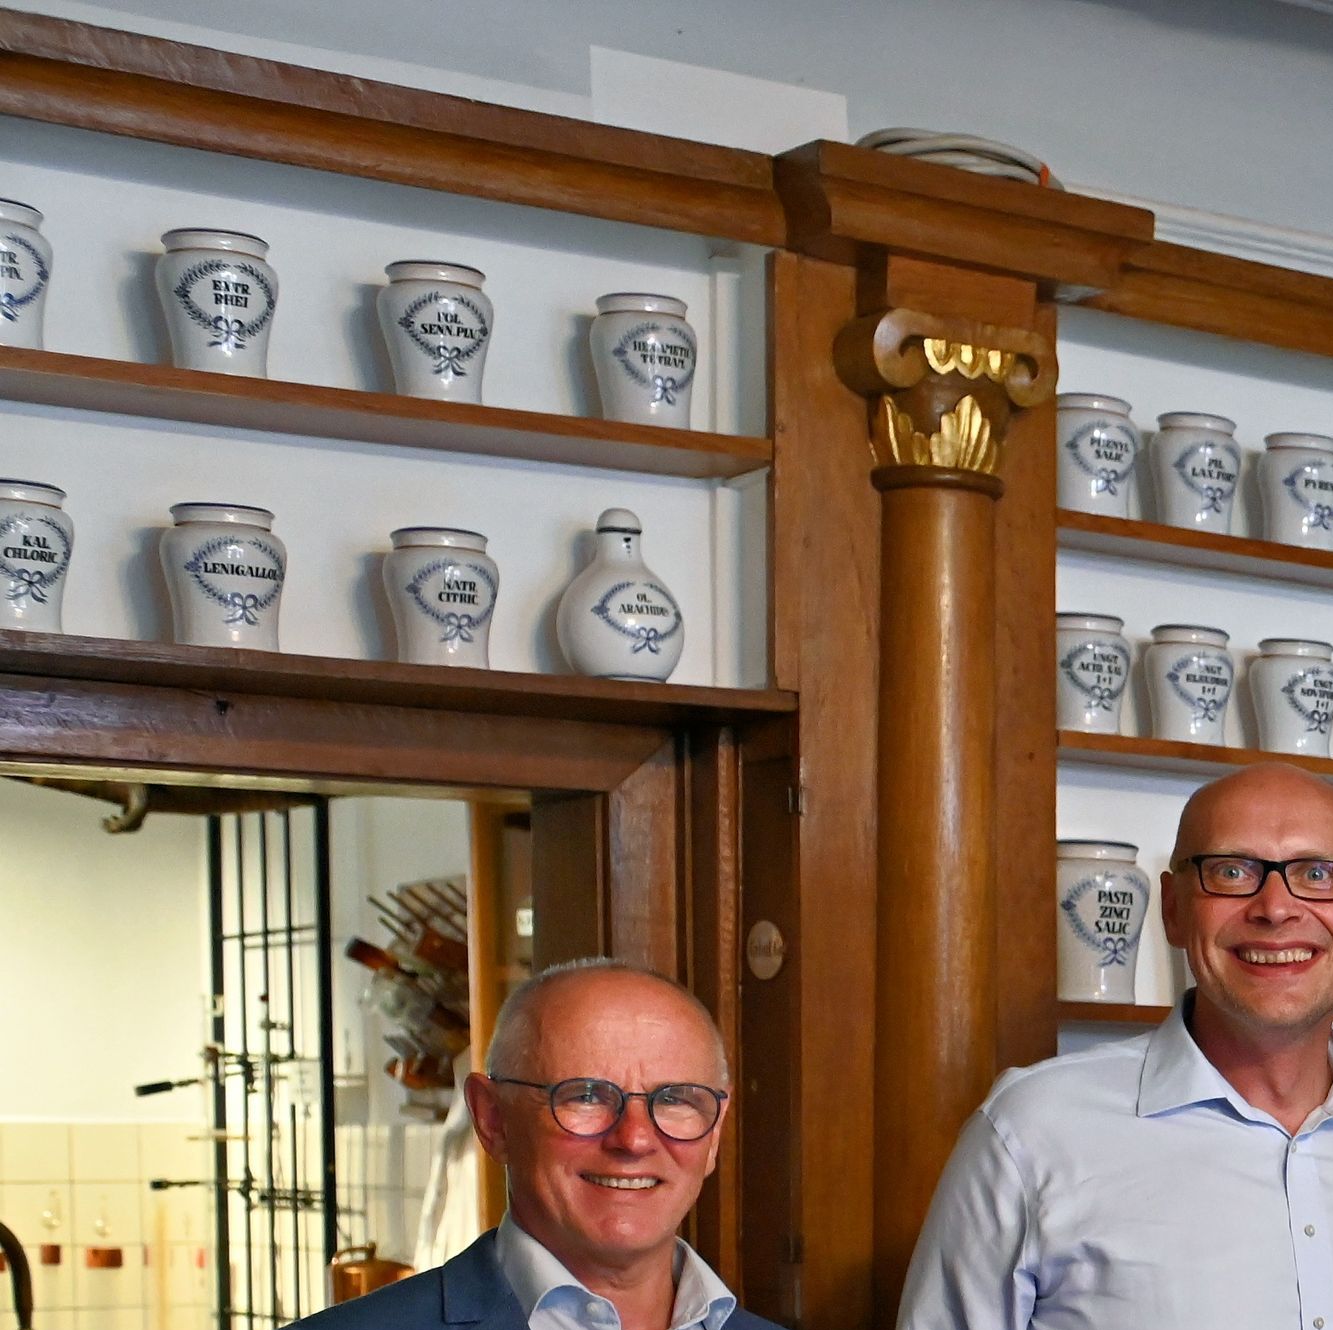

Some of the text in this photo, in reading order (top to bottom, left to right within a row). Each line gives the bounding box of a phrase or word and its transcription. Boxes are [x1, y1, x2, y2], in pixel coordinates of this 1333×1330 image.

[5, 547, 59, 563] CHLORIC
[1097, 889, 1134, 906] PASTA
[1095, 920, 1130, 936] SALIC
